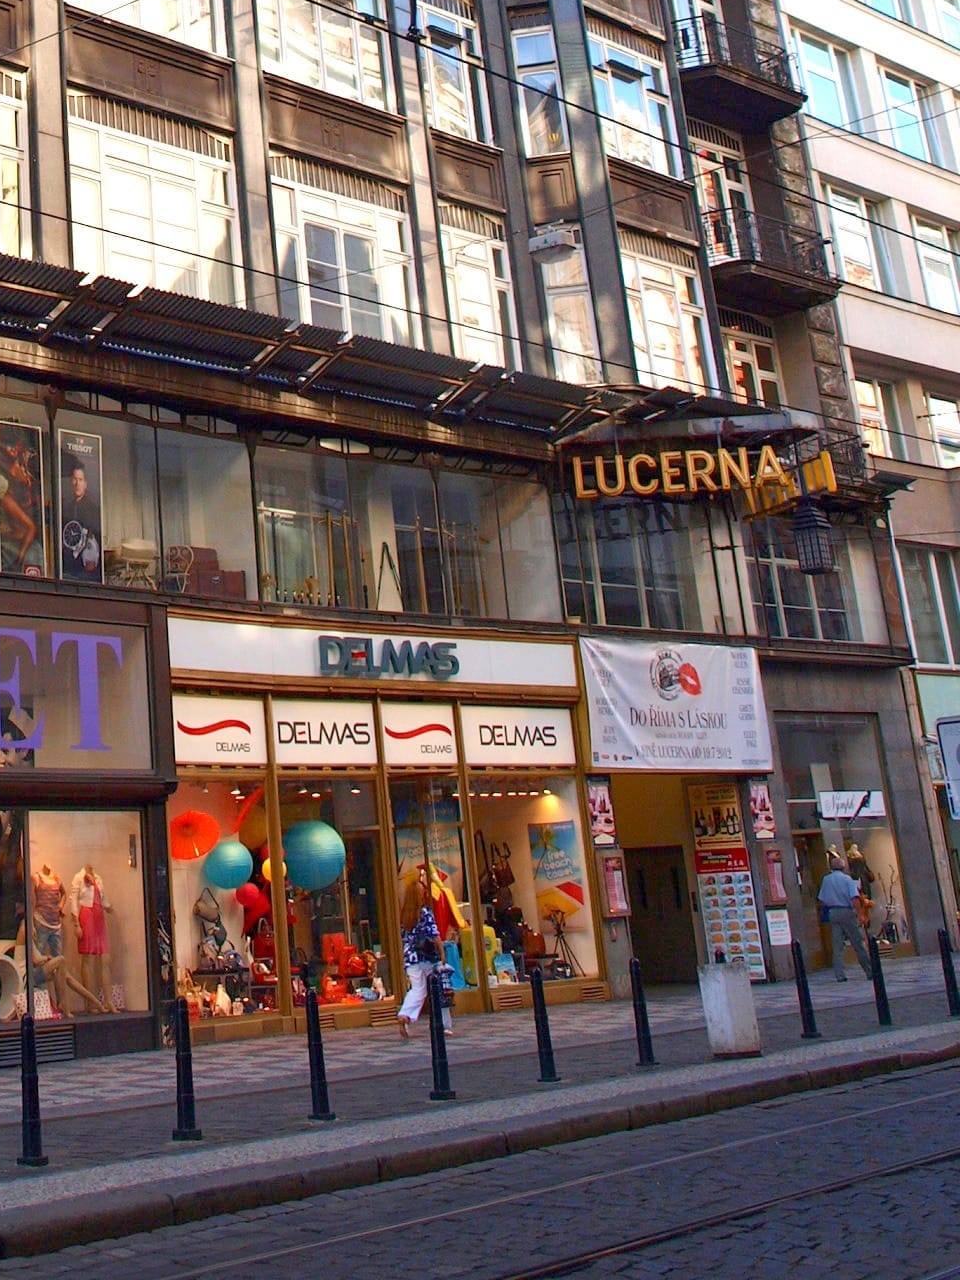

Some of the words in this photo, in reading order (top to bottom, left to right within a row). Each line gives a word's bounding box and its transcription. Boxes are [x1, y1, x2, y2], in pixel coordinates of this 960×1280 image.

[66, 442, 94, 454] TISSOT
[571, 445, 790, 500] LUCERNA
[318, 634, 460, 680] DELMAS
[629, 706, 647, 727] DO
[277, 721, 371, 745] DELMAS
[478, 724, 557, 747] DELMAS
[215, 741, 251, 753] DELMAS
[420, 744, 453, 754] DELMAS
[543, 858, 572, 871] beach
